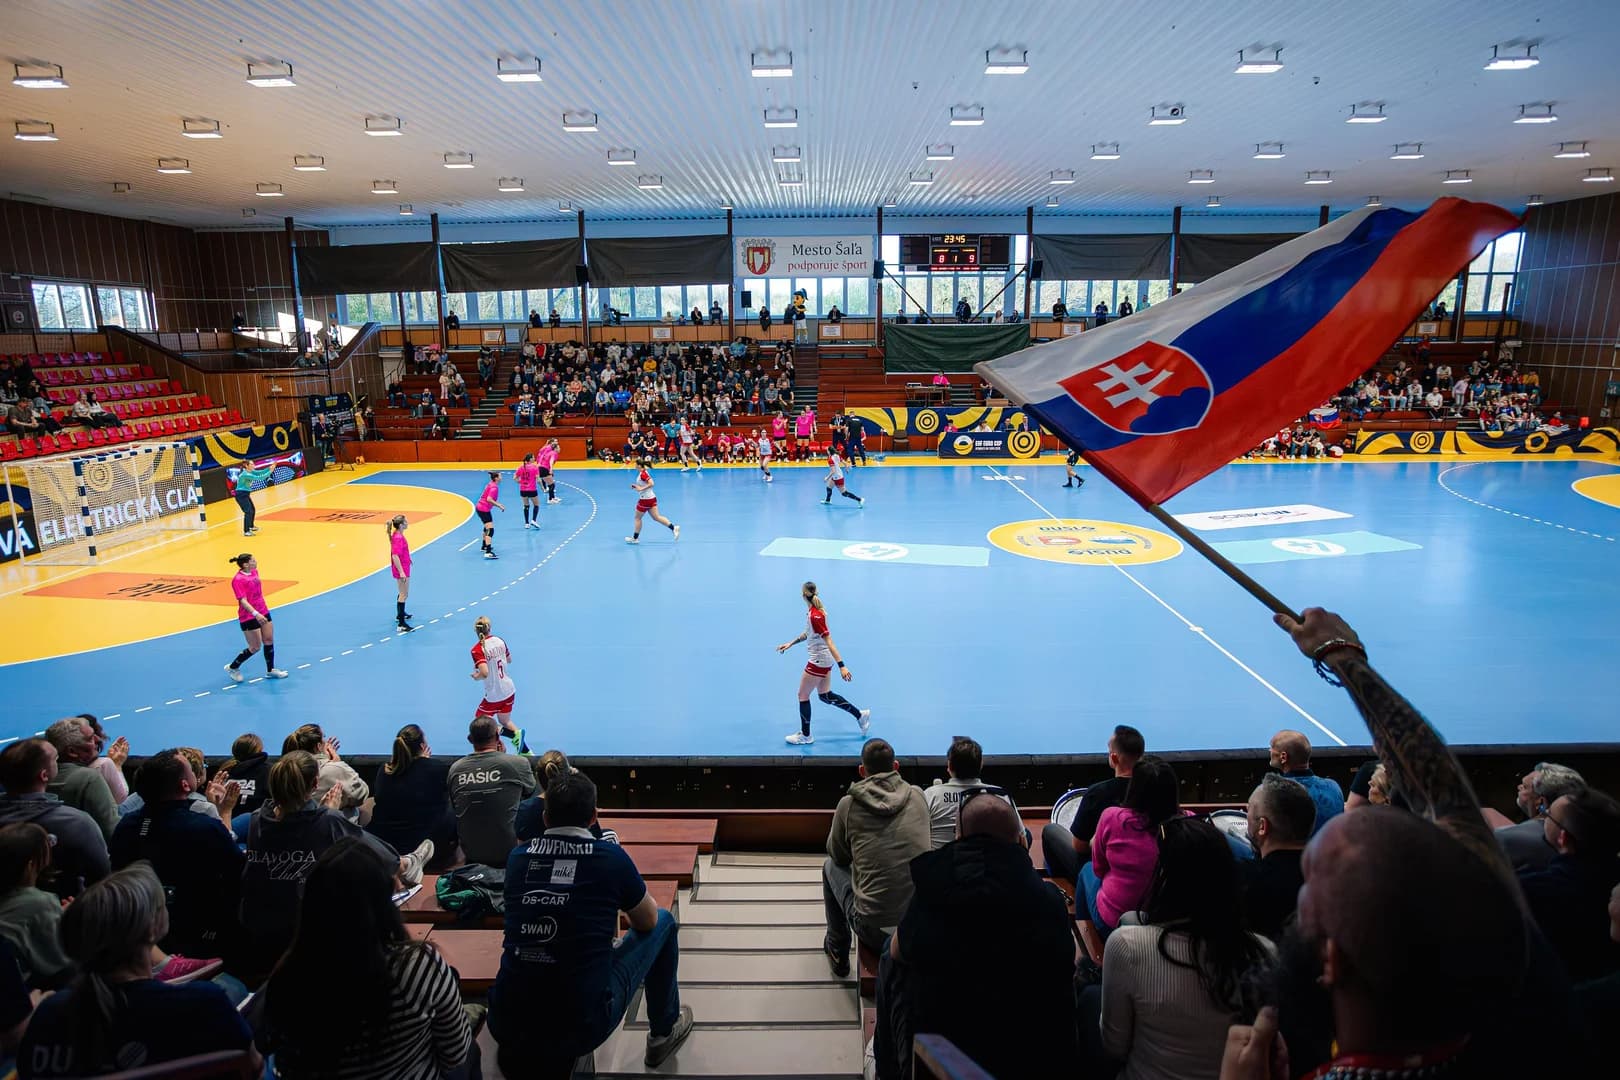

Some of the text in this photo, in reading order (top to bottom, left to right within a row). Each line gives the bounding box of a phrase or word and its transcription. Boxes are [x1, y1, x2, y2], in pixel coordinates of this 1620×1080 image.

[792, 241, 862, 255] Mesto Šaľa
[939, 254, 945, 263] 8
[969, 254, 975, 263] 9
[787, 260, 868, 272] podporuje šport
[497, 659, 504, 679] 5
[458, 769, 501, 785] BASIC
[520, 922, 552, 935] SWAN
